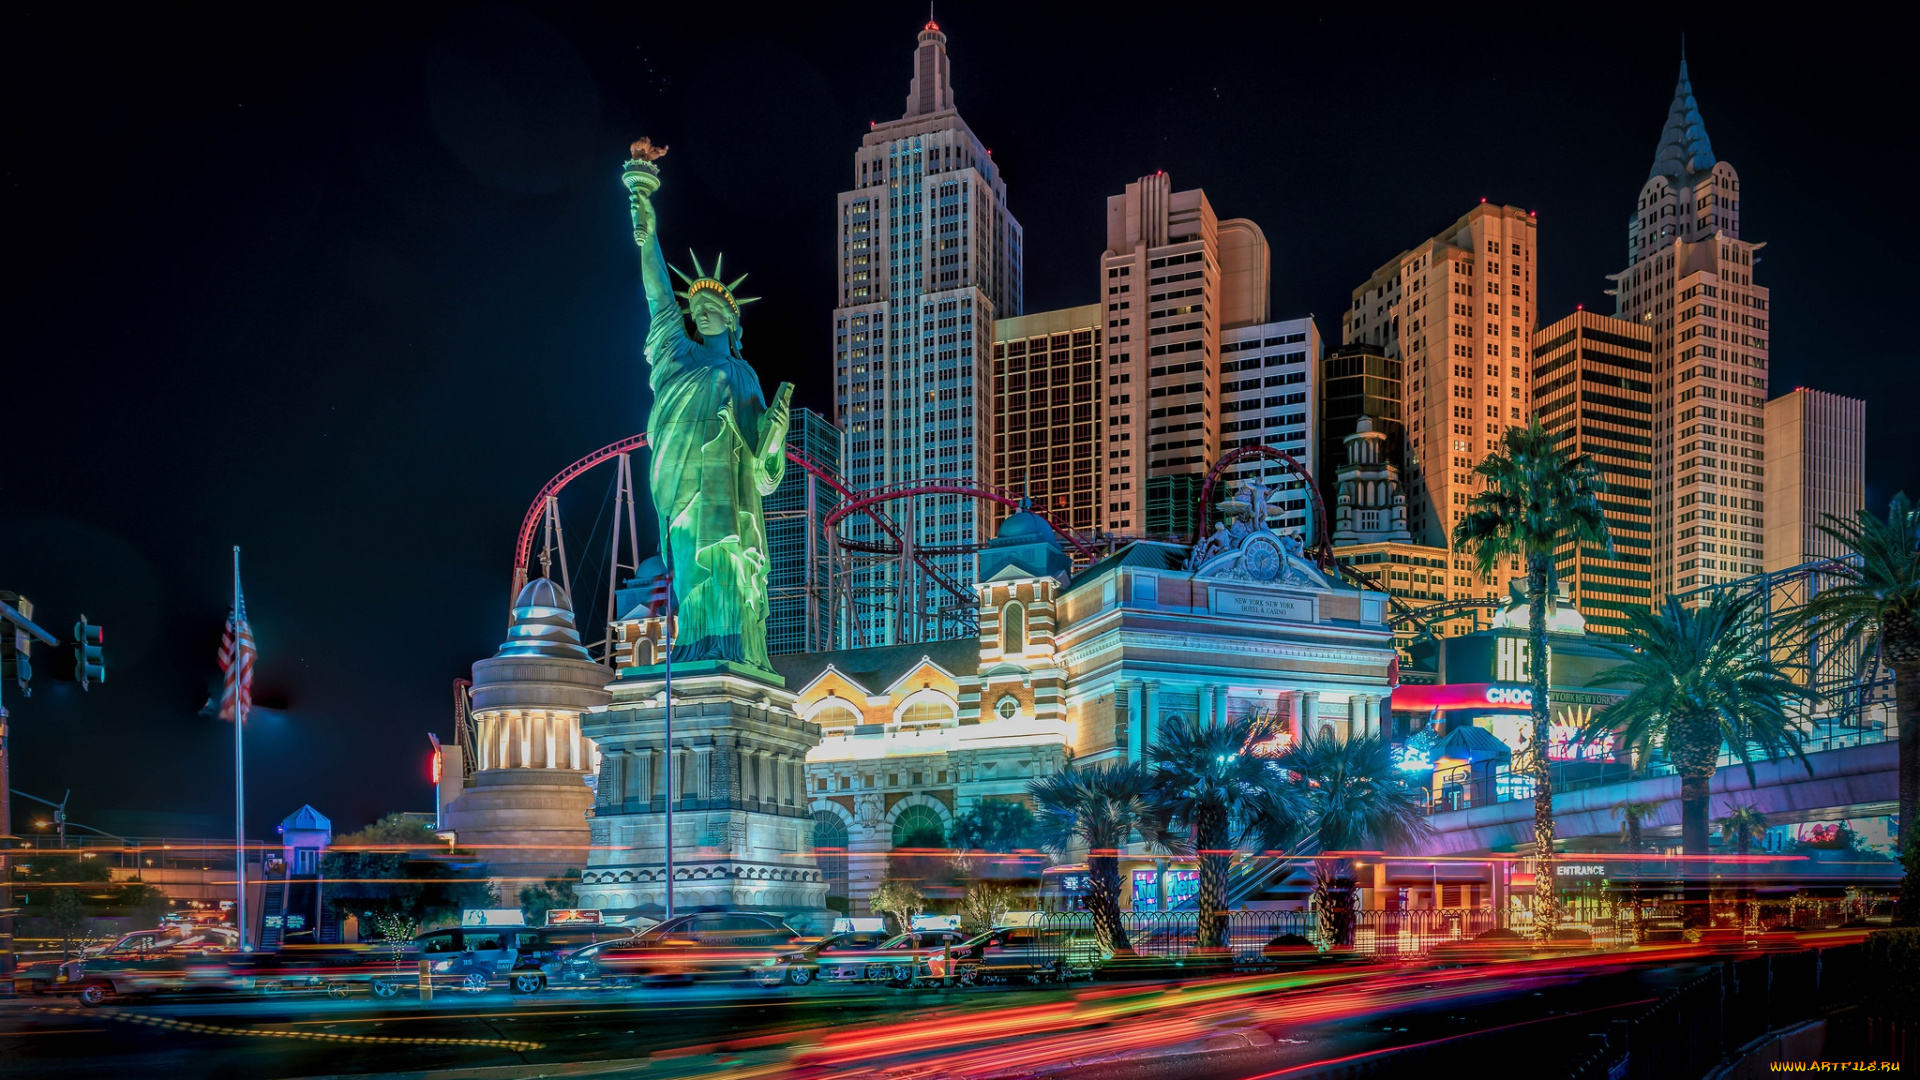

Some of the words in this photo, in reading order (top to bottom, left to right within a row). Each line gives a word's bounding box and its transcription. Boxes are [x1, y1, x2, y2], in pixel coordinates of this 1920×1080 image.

[1249, 598, 1264, 606] YORK
[1241, 605, 1259, 613] HOTEL
[1497, 637, 1532, 682] HE
[1557, 865, 1604, 875] ENTRANCE
[1135, 875, 1199, 899] Twzlers
